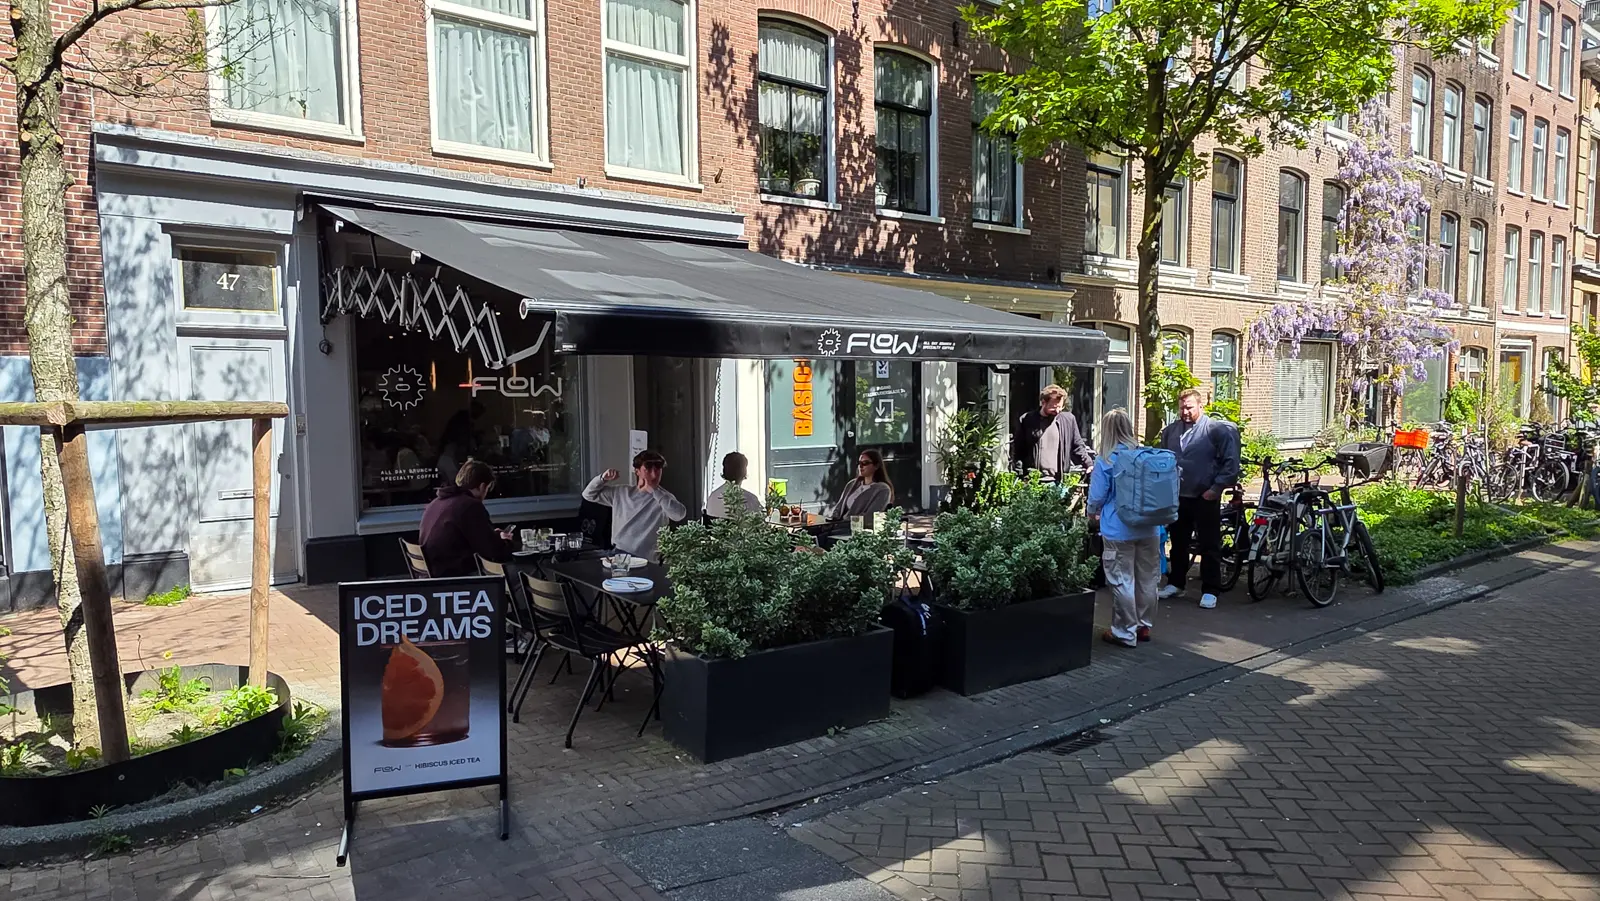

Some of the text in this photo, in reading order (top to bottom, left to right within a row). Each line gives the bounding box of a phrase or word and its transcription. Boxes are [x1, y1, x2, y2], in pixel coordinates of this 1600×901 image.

[216, 272, 240, 291] 47
[846, 332, 919, 355] FLOW
[471, 376, 562, 398] FLOW
[353, 589, 494, 621] ICED TEA
[356, 616, 492, 647] DREAMS
[374, 765, 402, 774] FLOW
[414, 761, 449, 770] HIBISCUS
[449, 758, 466, 766] ICED
